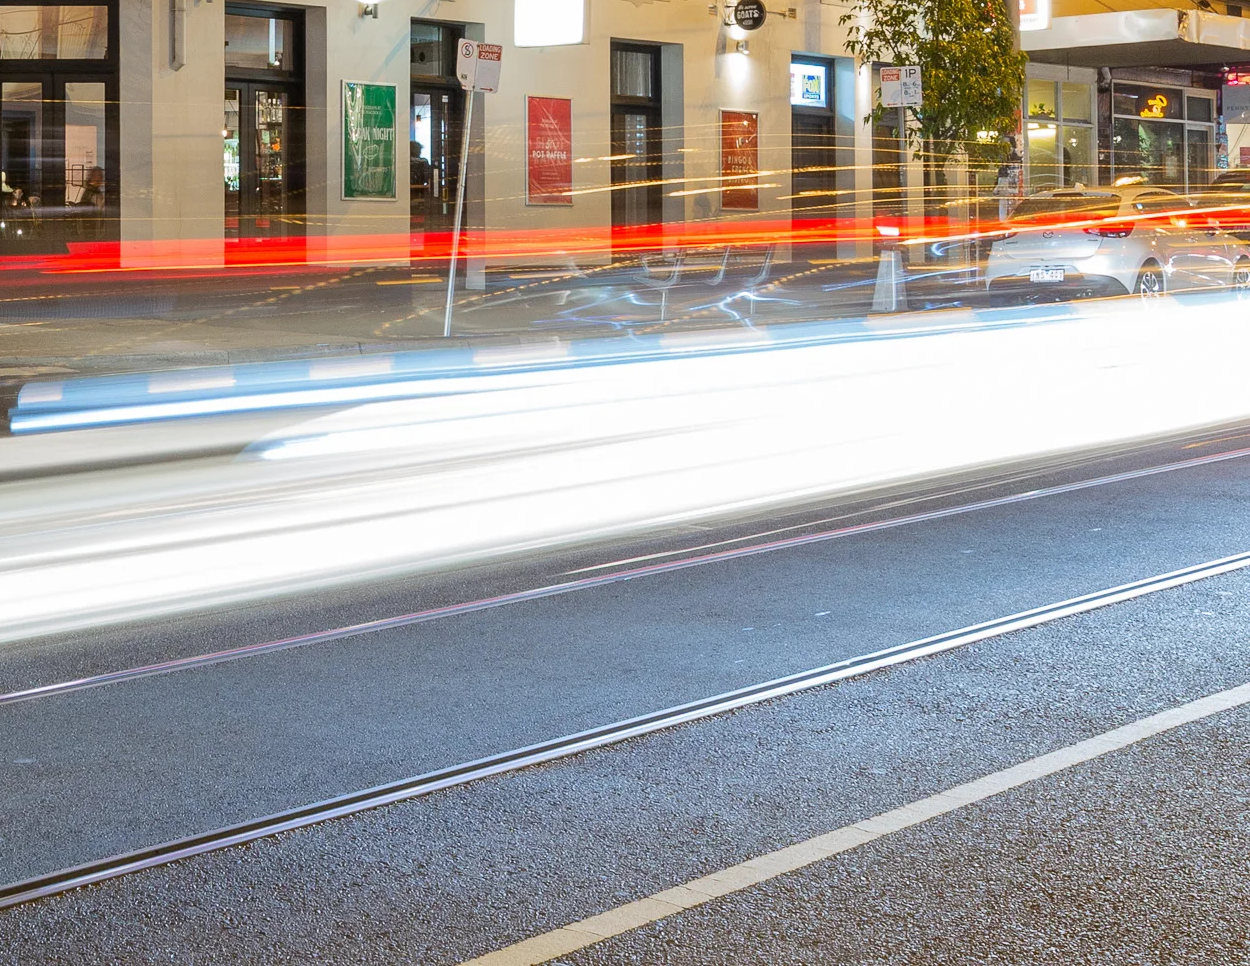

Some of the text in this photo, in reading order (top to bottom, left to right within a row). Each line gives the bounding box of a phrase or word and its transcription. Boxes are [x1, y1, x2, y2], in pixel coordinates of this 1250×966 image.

[479, 44, 501, 53] LOADING
[480, 52, 499, 60] ZONE
[904, 68, 917, 78] 1P
[532, 150, 567, 161] POT RAFFLE
